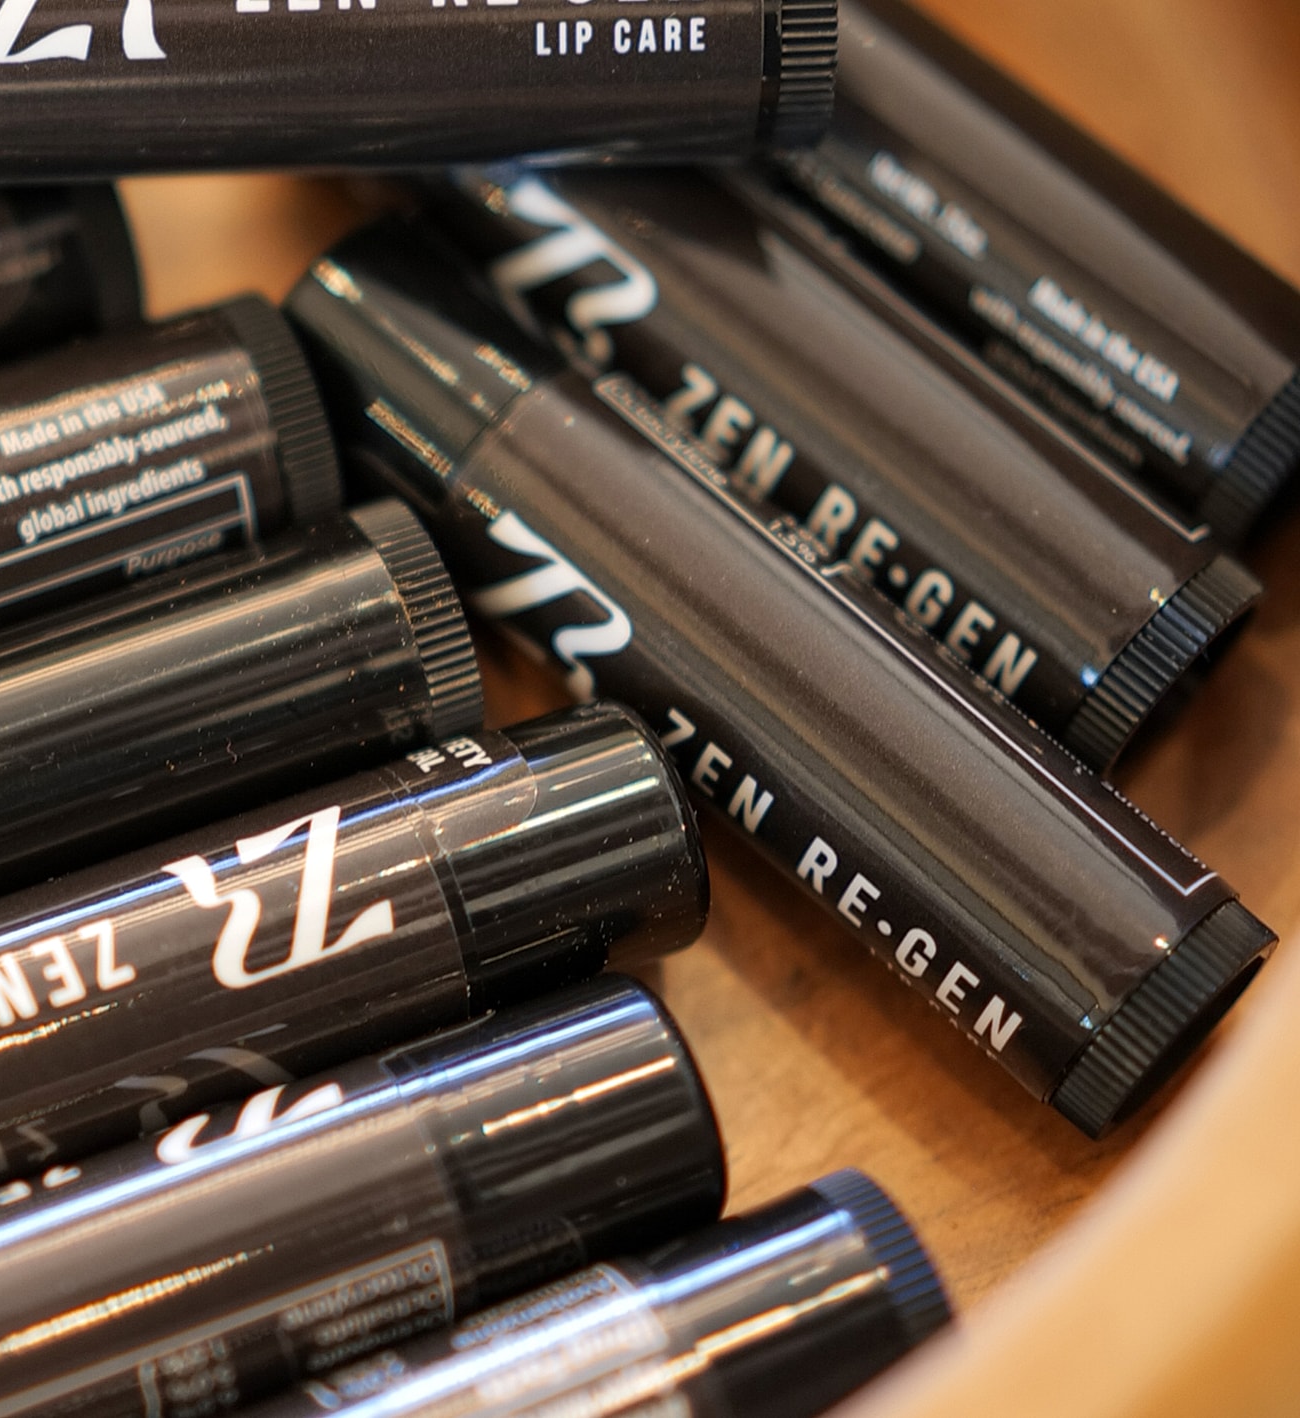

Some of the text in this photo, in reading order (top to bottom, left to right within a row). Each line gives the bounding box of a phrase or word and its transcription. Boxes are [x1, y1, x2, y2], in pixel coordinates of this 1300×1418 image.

[536, 17, 706, 56] LIP CARE
[20, 406, 229, 498] responsibly-sourced,
[61, 413, 83, 437] in
[84, 399, 120, 430] the
[123, 383, 166, 417] USA
[663, 363, 795, 503] ZEN
[18, 460, 205, 544] global ingredients
[125, 530, 222, 575] Purpose
[658, 708, 775, 835] ZEN
